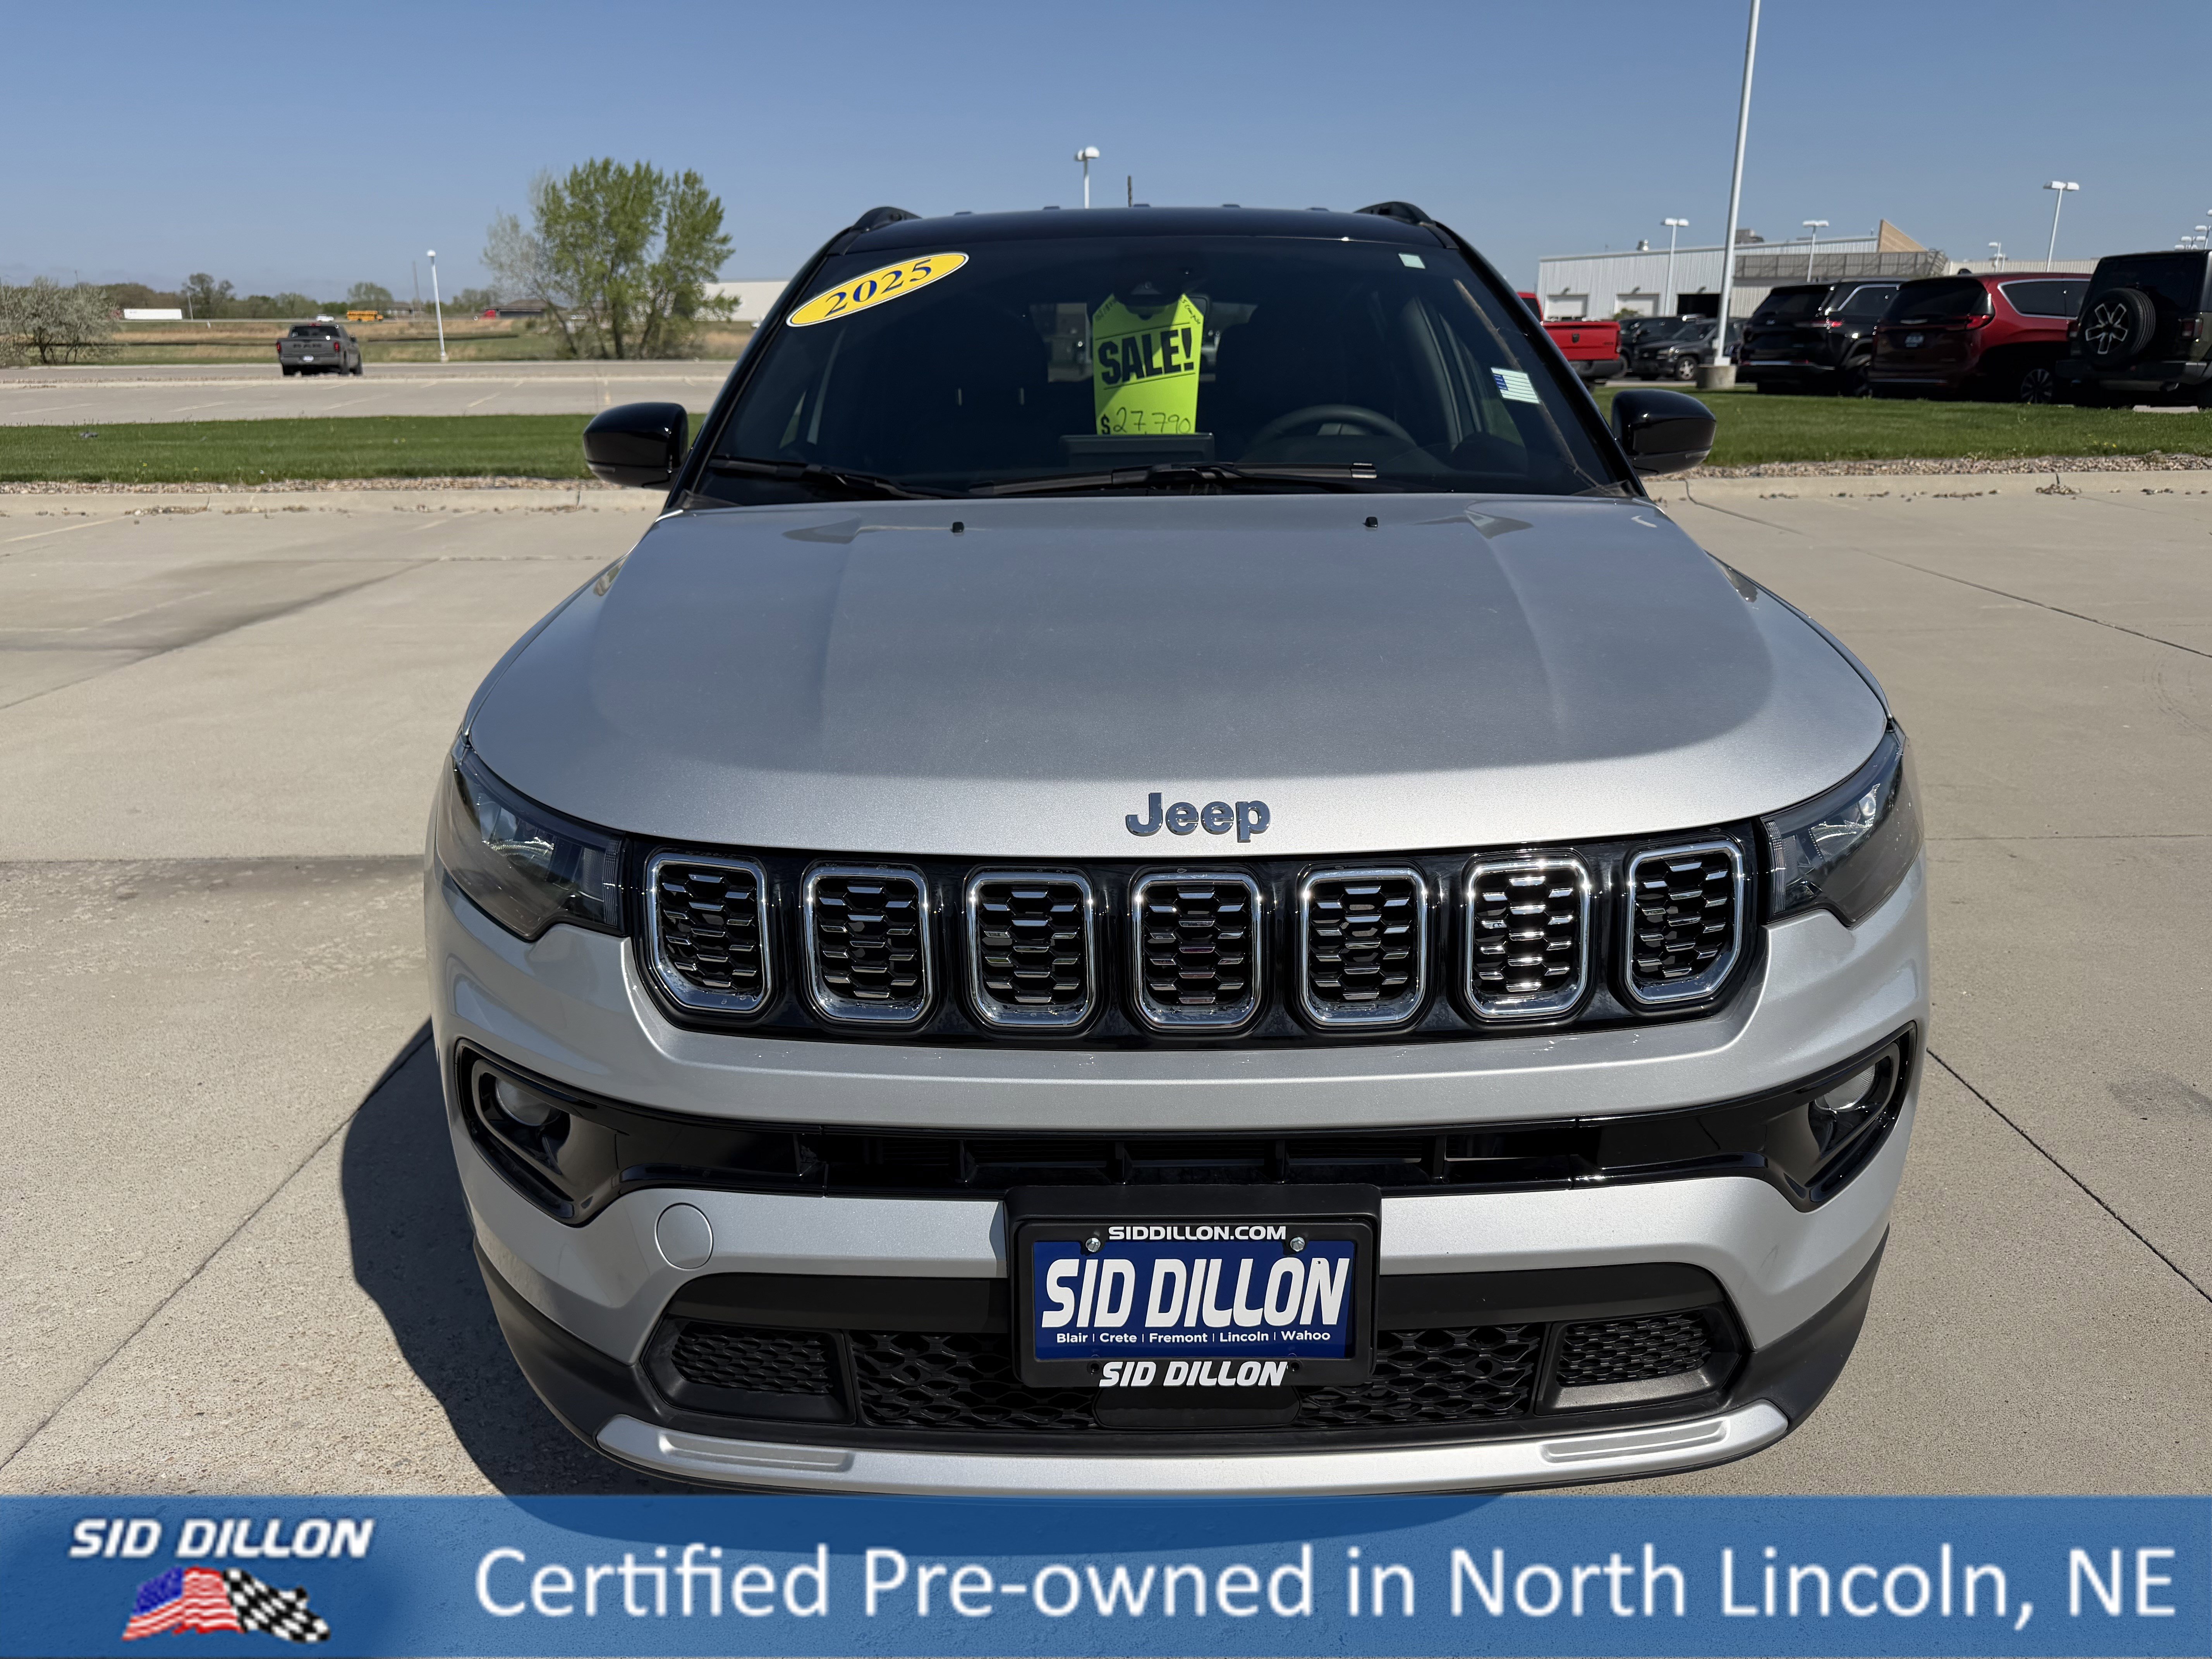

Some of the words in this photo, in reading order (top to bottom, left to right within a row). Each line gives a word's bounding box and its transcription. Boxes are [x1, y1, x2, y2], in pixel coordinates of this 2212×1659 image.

[823, 259, 932, 318] 2025
[1098, 327, 1194, 385] SALE!
[1125, 792, 1270, 843] Jeep
[1108, 1226, 1286, 1240] SIDDILLON.COM
[1041, 1258, 1136, 1328] SID
[1145, 1257, 1350, 1328] DILLON
[1056, 1333, 1088, 1343] Blair
[1099, 1333, 1137, 1343] Crete
[1149, 1333, 1208, 1343] Fremont
[1219, 1331, 1269, 1342] Lincoln
[1281, 1330, 1331, 1341] Wahoo
[1099, 1361, 1156, 1387] SID
[1163, 1360, 1288, 1386] DILLON
